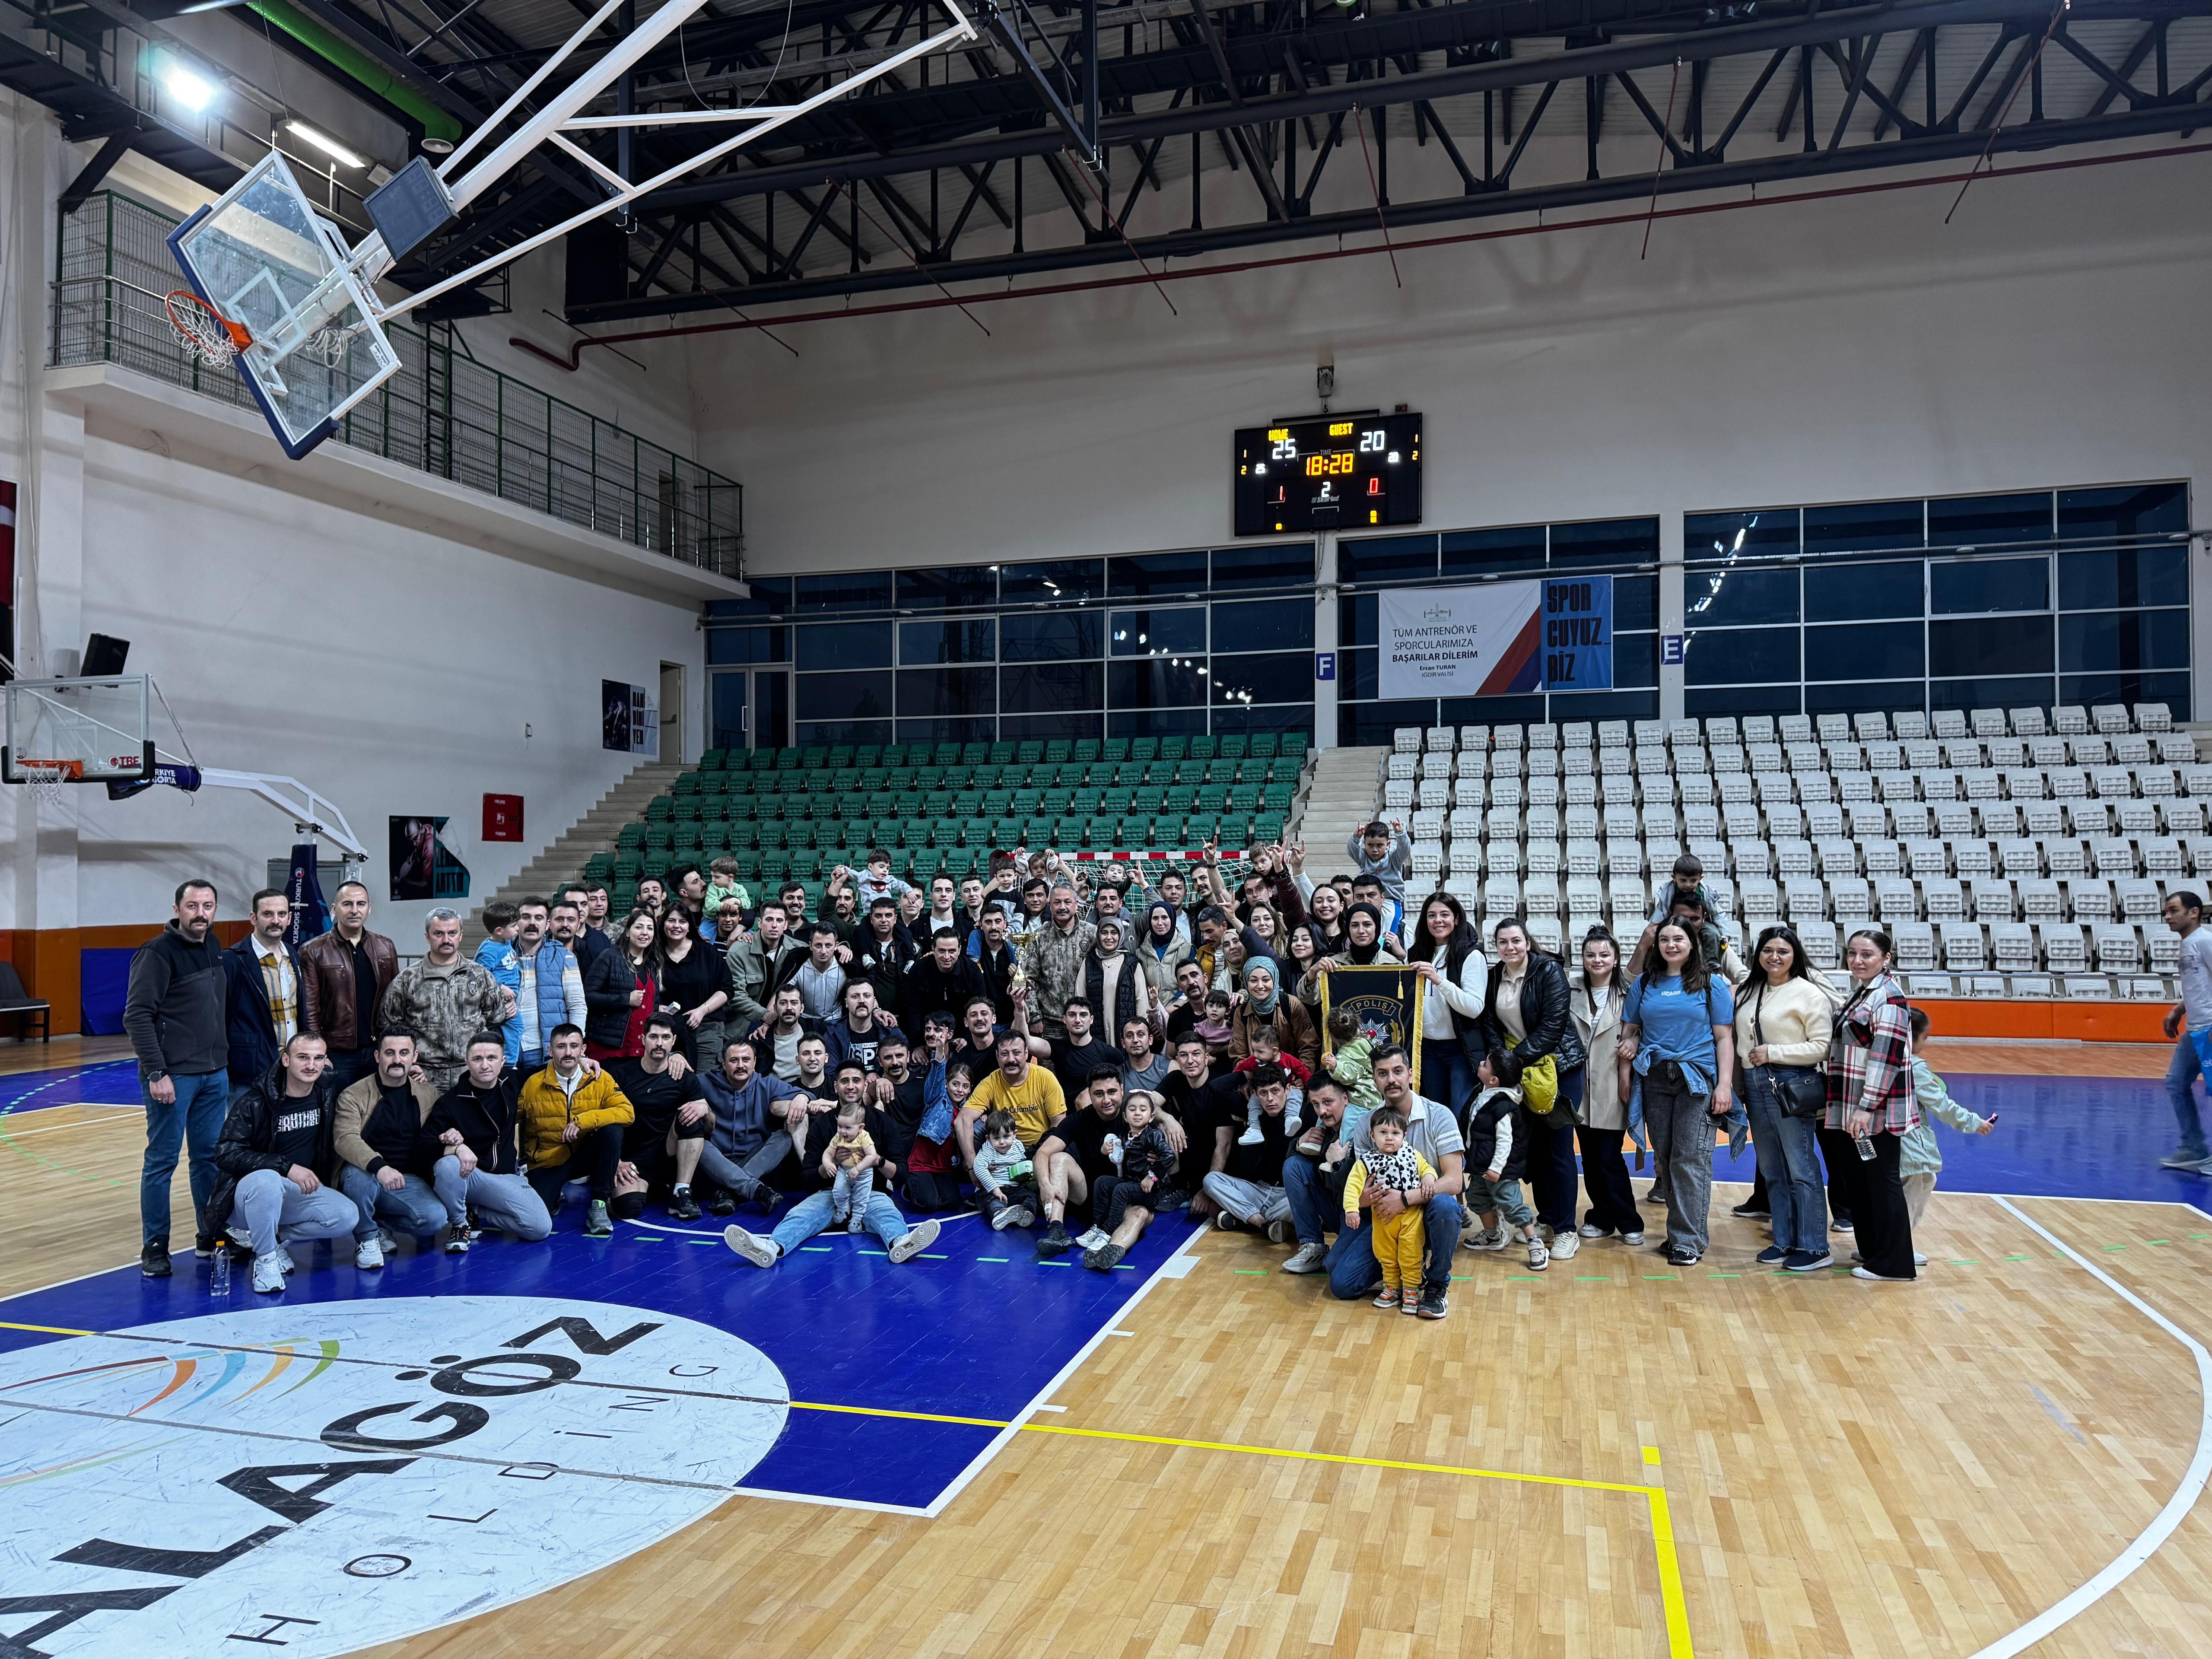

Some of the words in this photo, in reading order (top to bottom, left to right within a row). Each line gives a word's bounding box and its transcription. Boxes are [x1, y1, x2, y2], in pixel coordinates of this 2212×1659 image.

[1268, 429, 1288, 441] HOME
[1329, 423, 1353, 436] GUEST
[1360, 430, 1385, 452] 20
[1415, 434, 1418, 443] 1
[1243, 449, 1247, 458] 1
[1272, 438, 1296, 459] 25
[1412, 450, 1418, 460] 2
[1241, 465, 1247, 475] 2
[1306, 453, 1354, 476] 18:28
[1279, 486, 1283, 500] 1
[1321, 481, 1331, 497] 2
[1369, 478, 1379, 494] 0
[1547, 583, 1591, 613] SPOR
[1393, 627, 1412, 638] TÜM
[1415, 624, 1464, 637] ANTRENÖR
[1465, 625, 1478, 634] VE
[1547, 617, 1602, 648] CUYUZ
[1395, 638, 1473, 651] SPORCULARIMIZA
[1664, 639, 1679, 660] E
[1392, 653, 1440, 664] BAŞARILAR
[1442, 650, 1478, 660] DİLERİM
[1319, 657, 1332, 676] F
[1548, 651, 1575, 682] BİZ
[1356, 1000, 1388, 1009] POLİS
[1009, 1104, 1039, 1113] Columbia
